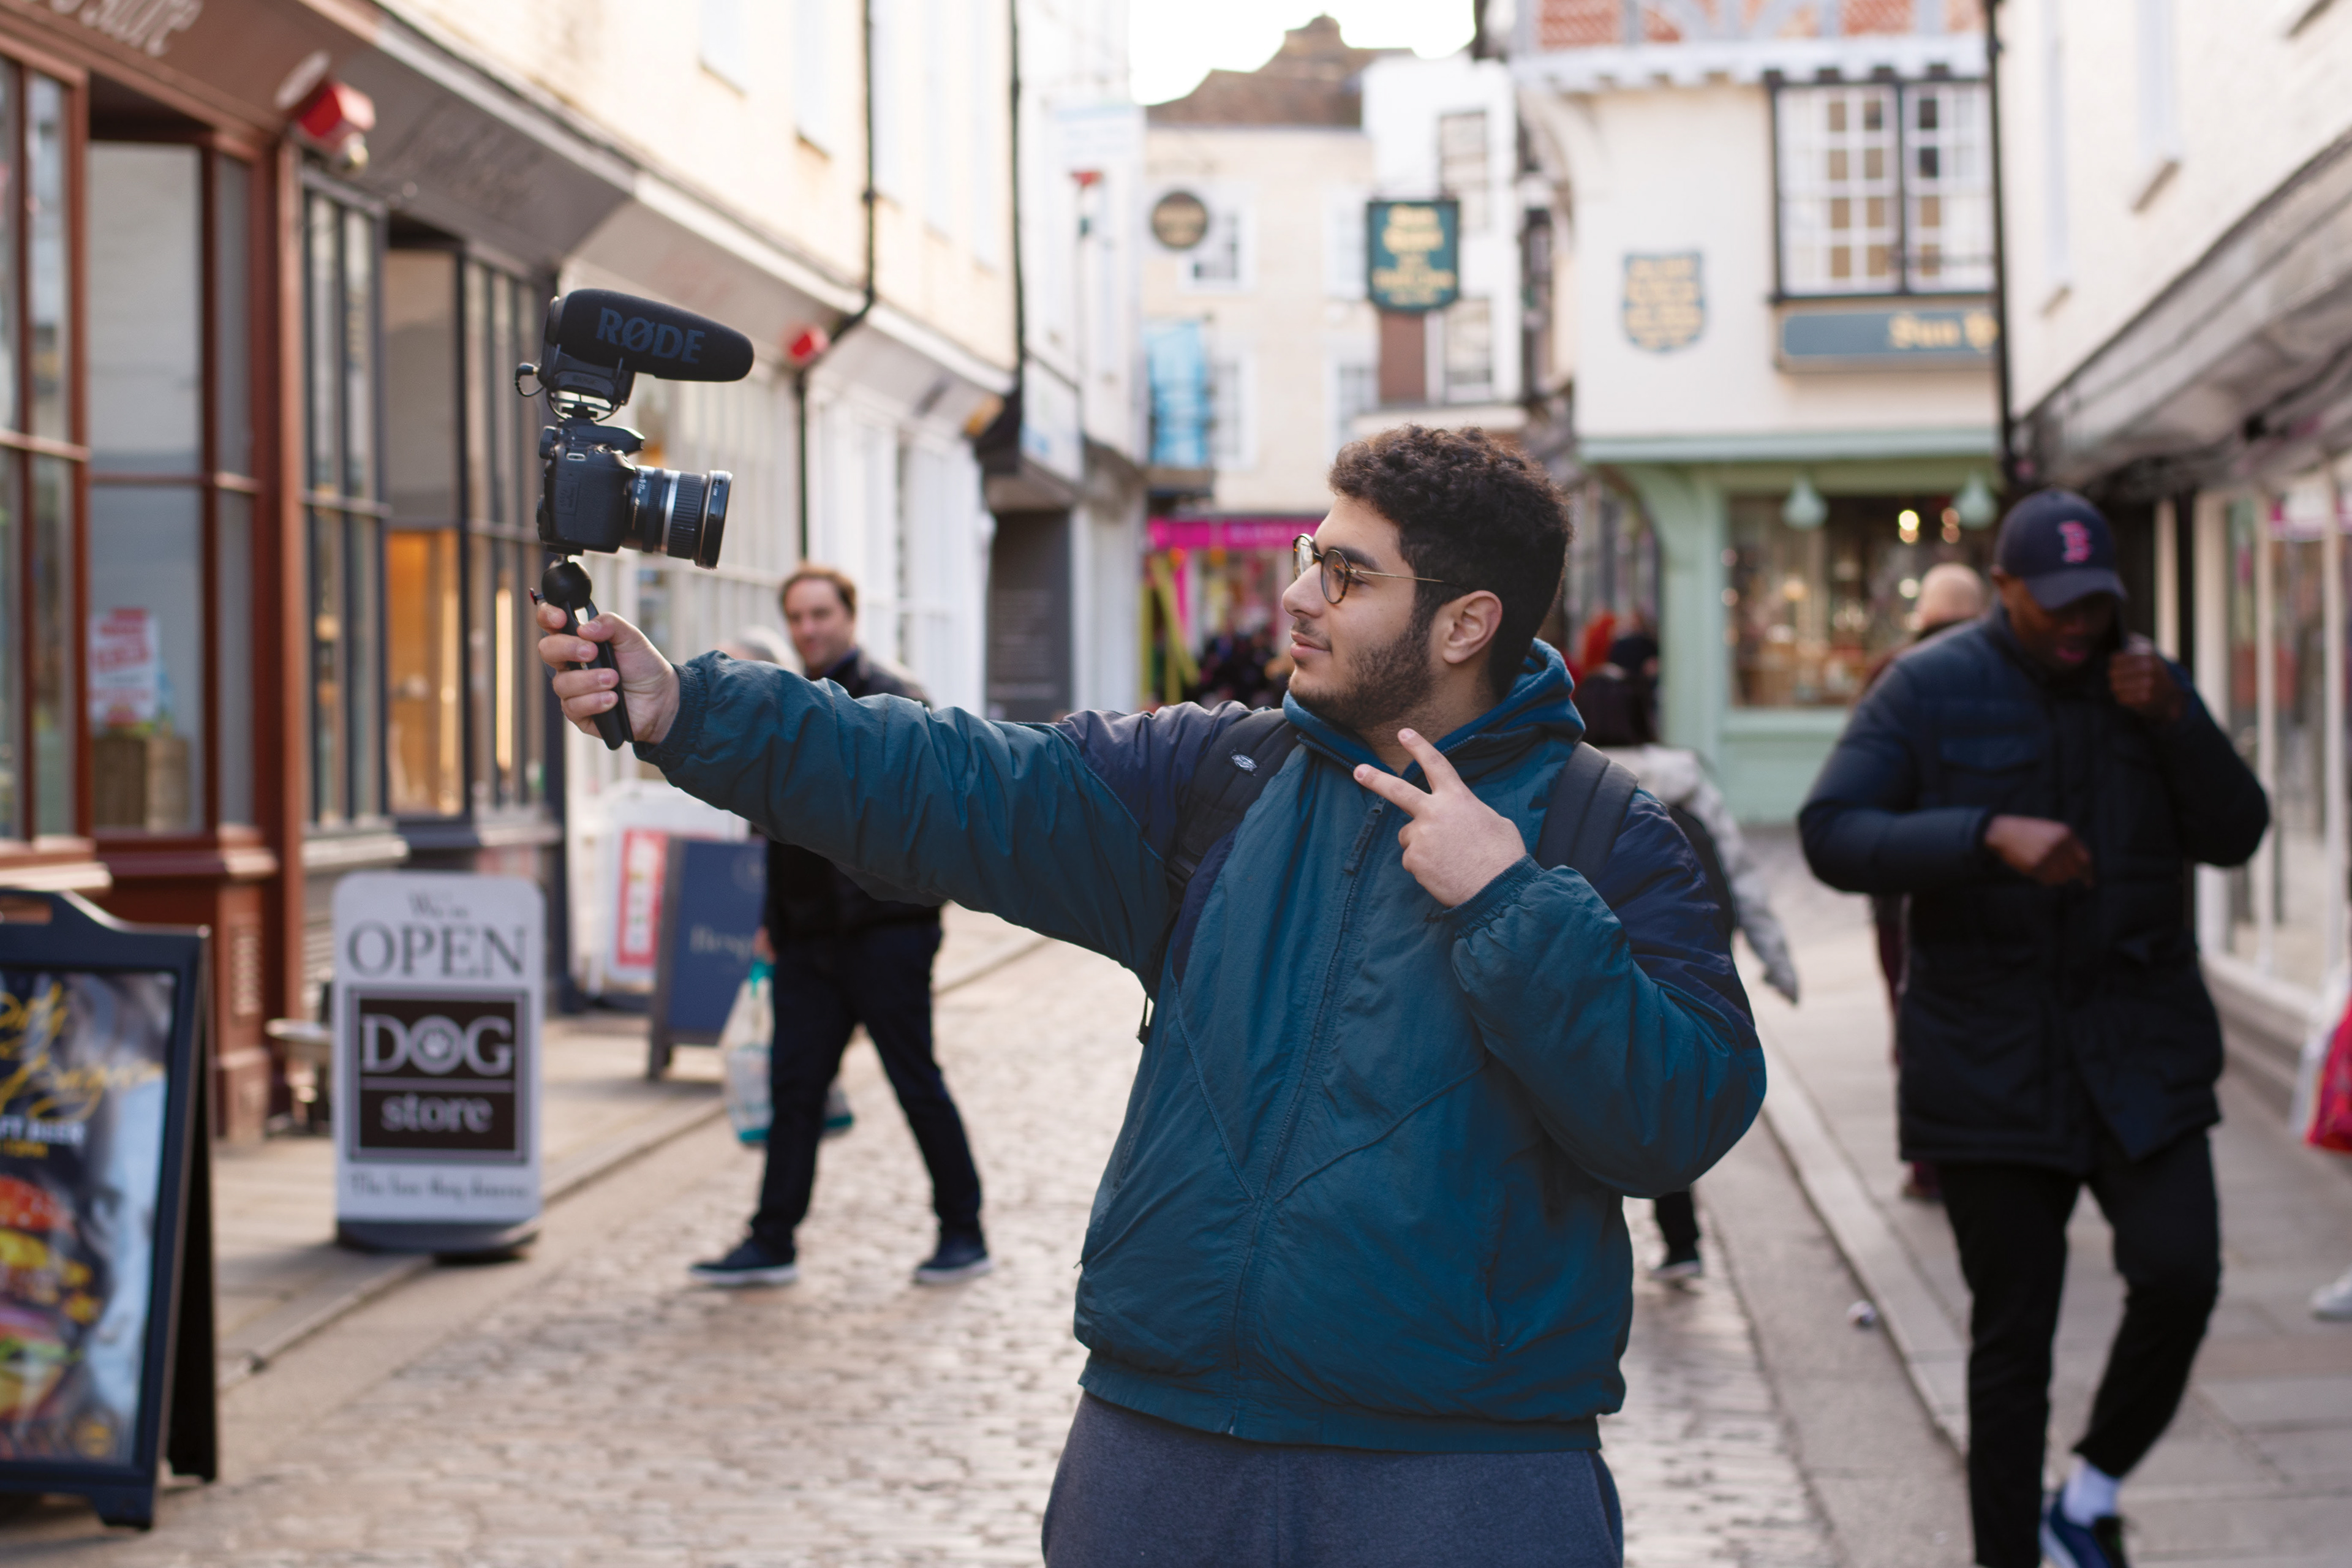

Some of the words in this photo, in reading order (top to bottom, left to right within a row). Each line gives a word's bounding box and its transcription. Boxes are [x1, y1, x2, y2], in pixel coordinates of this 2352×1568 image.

[596, 307, 705, 363] RØDE
[2057, 520, 2092, 564] B
[347, 921, 527, 978] OPEN
[361, 1014, 513, 1076] DOG
[380, 1092, 493, 1133] store
